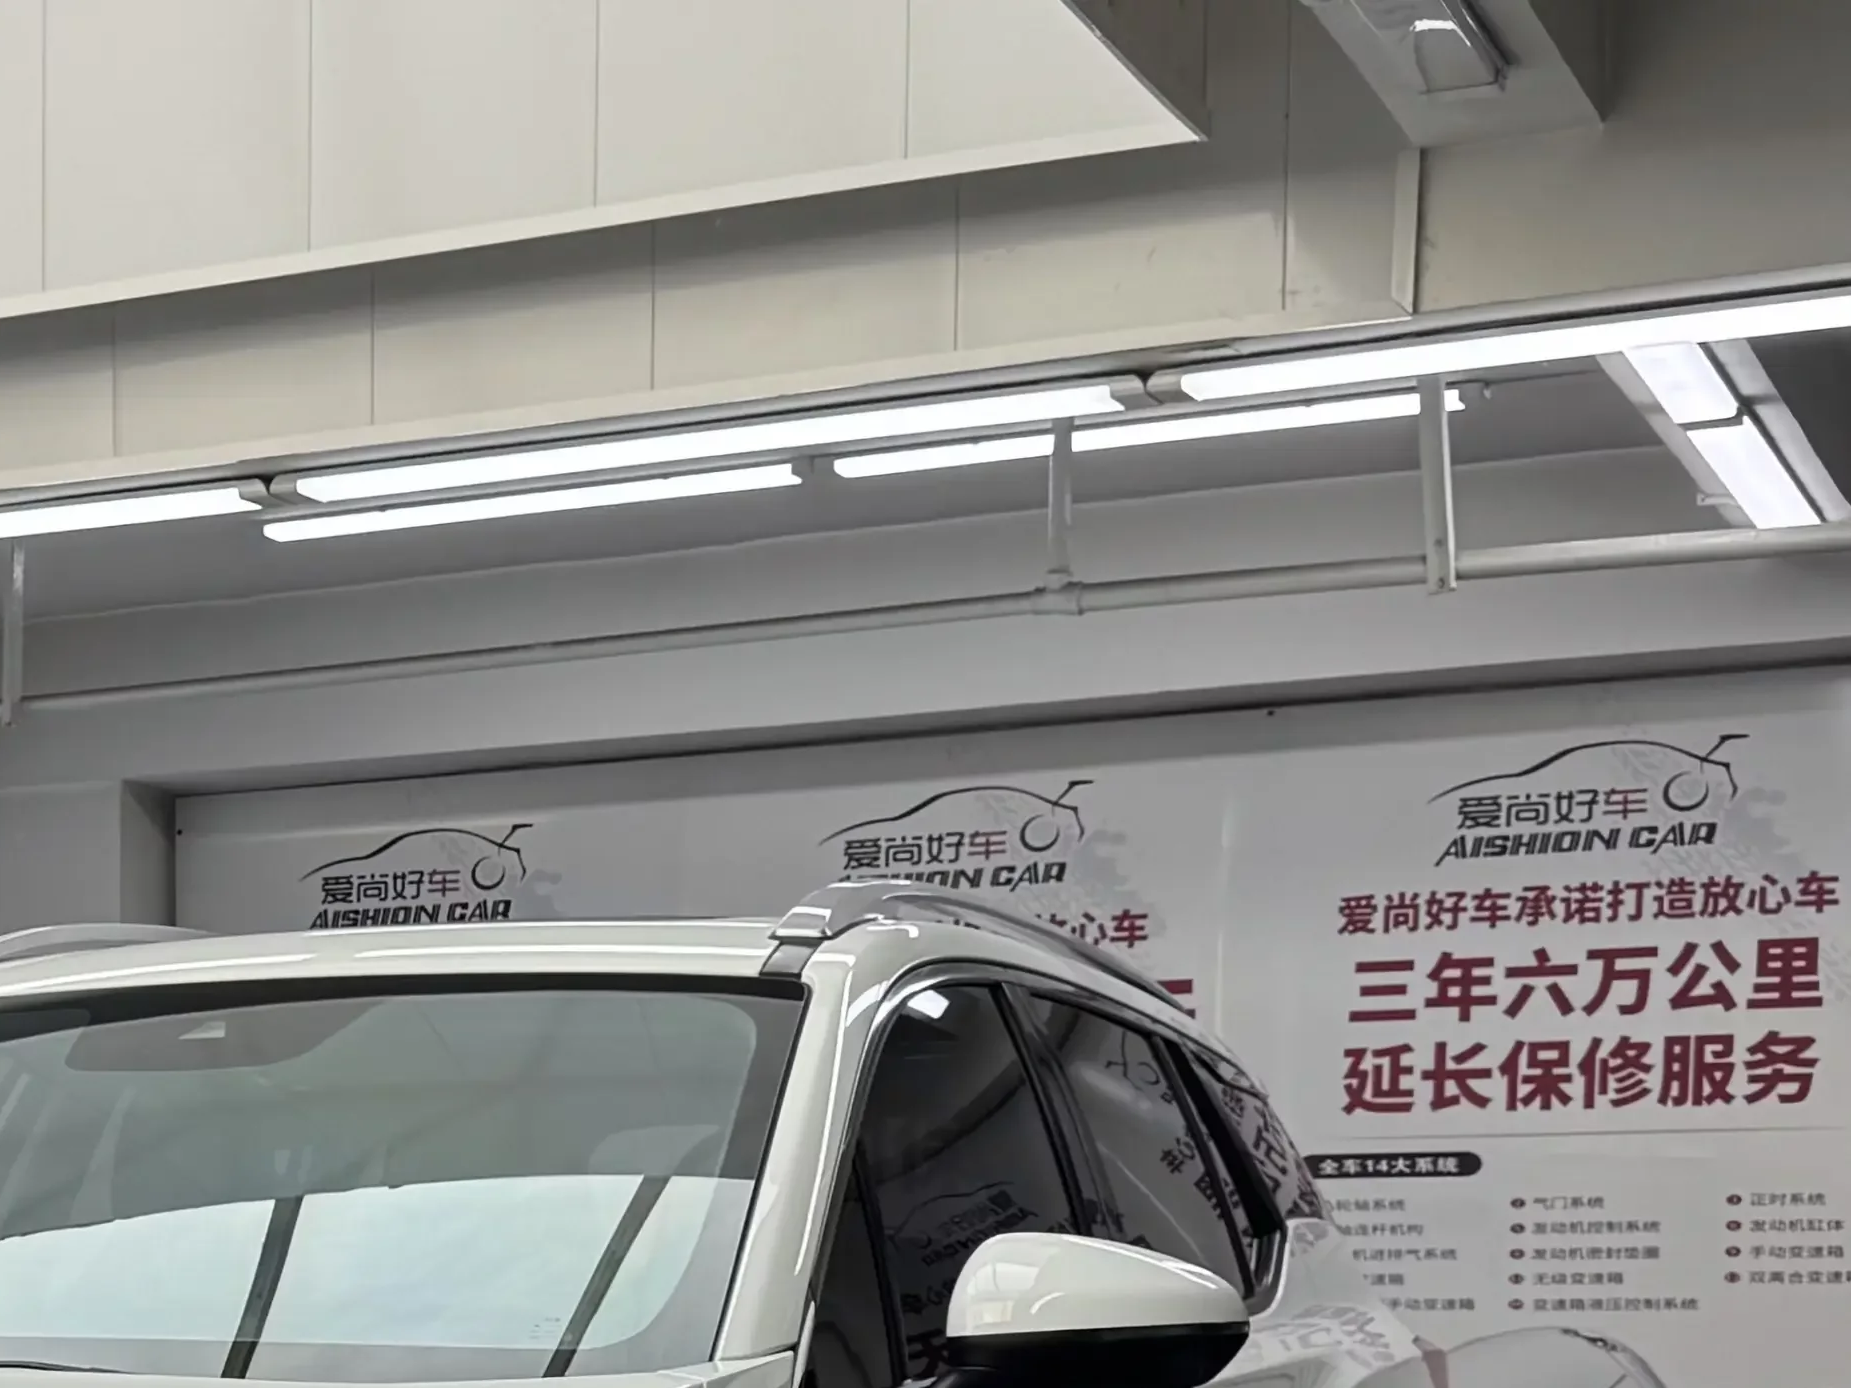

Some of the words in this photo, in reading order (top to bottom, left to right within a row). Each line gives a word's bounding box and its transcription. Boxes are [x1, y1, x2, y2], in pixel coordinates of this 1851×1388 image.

[1457, 788, 1648, 830] 爱尚好车
[843, 831, 1007, 870] 爱尚好车
[1434, 828, 1621, 867] AISHION
[1629, 822, 1718, 854] CAR
[321, 869, 461, 904] 爱尚好车
[990, 861, 1066, 892] CAR
[447, 899, 512, 922] CAR
[1338, 871, 1839, 935] 爱尚好车承诺打造放心车
[1348, 937, 1823, 1022] 三年六万公里
[1342, 1030, 1820, 1115] 延长保修服务
[1318, 1156, 1459, 1175] 全车14大系统
